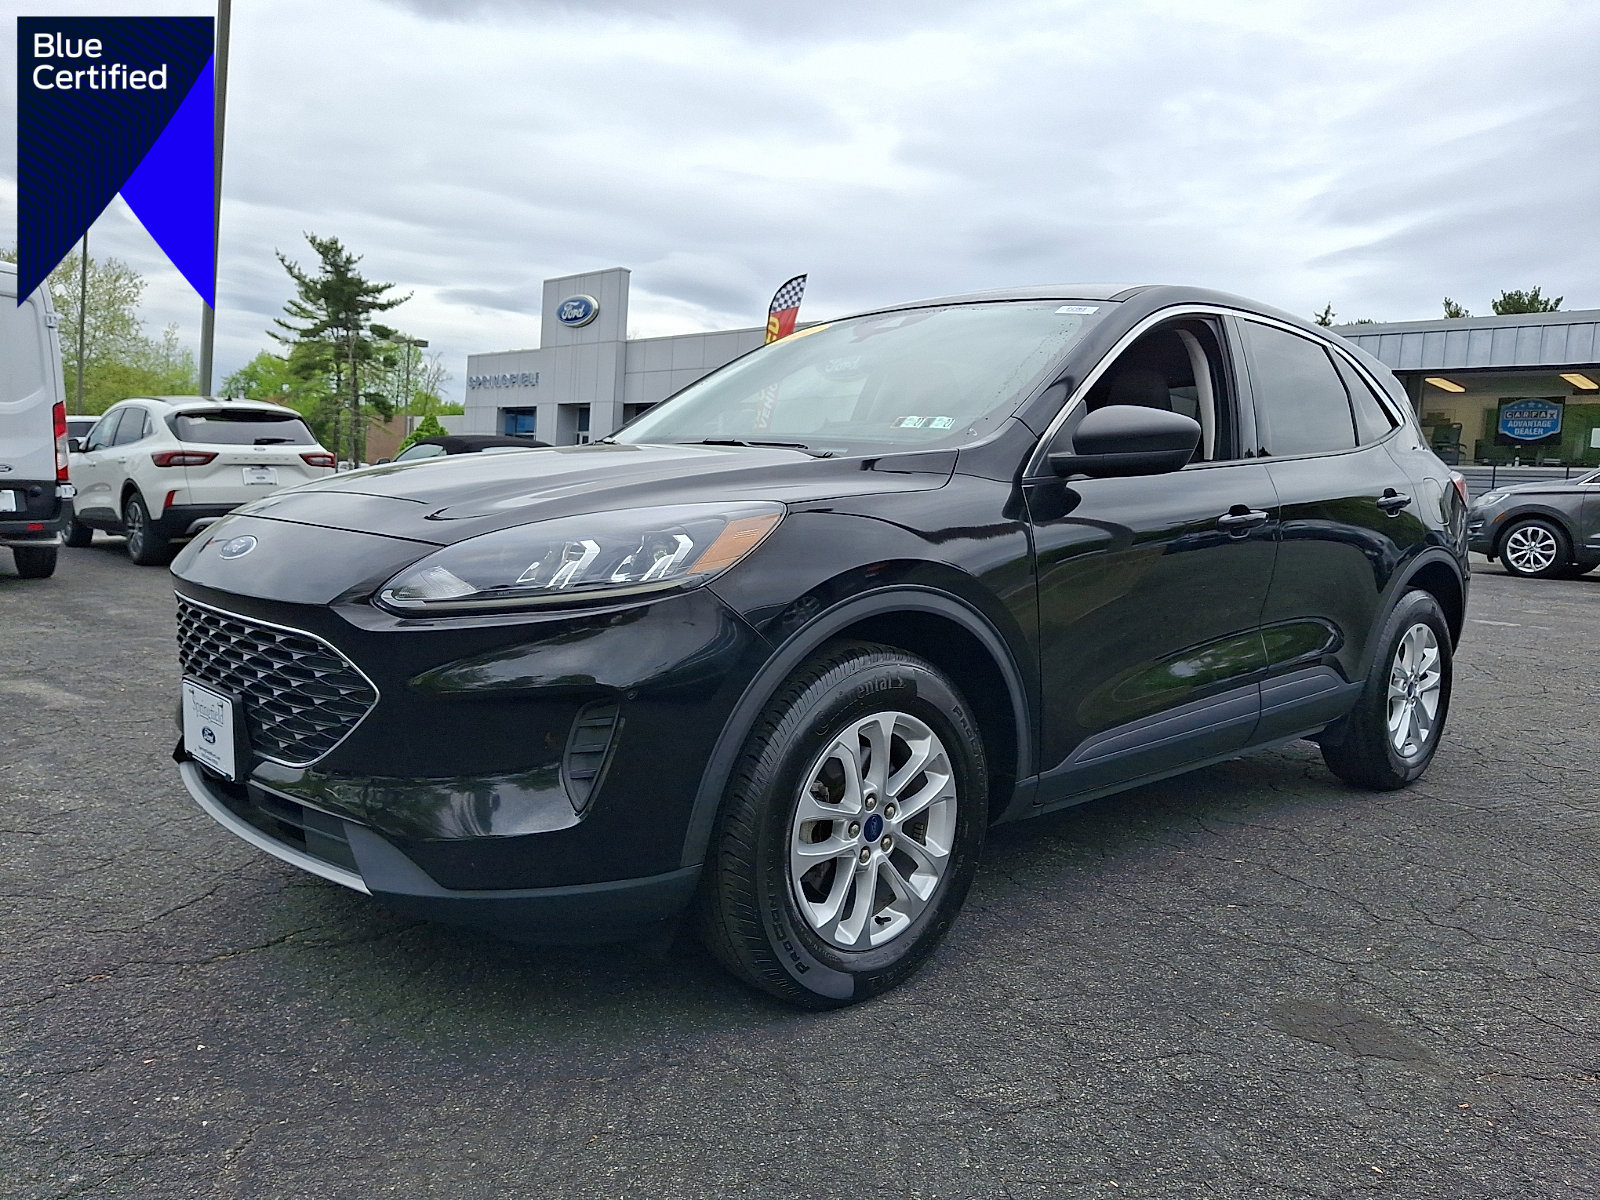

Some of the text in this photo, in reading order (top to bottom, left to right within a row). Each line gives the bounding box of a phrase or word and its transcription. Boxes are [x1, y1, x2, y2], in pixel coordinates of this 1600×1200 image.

[561, 301, 585, 320] Ford
[1504, 410, 1558, 420] CARFAX
[1507, 420, 1552, 428] ADVANTAGE
[1514, 428, 1544, 436] DEALER
